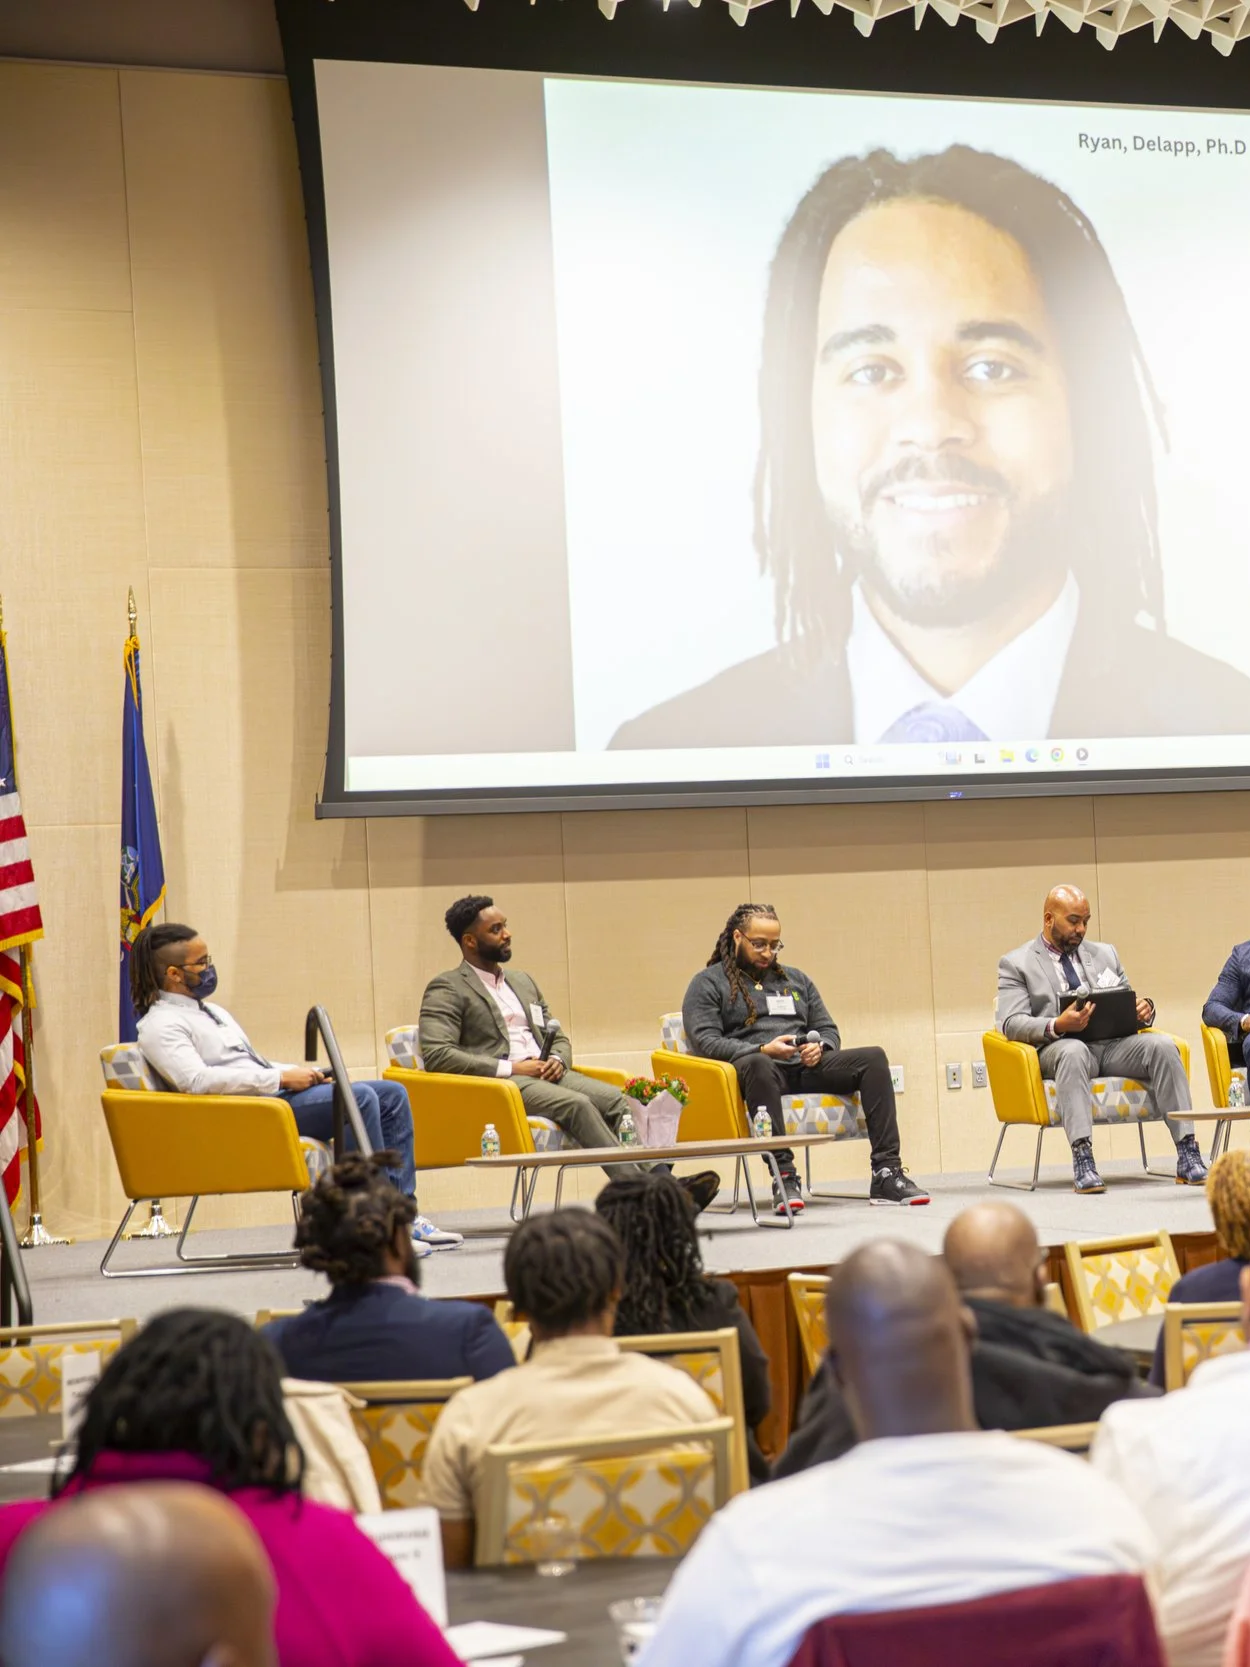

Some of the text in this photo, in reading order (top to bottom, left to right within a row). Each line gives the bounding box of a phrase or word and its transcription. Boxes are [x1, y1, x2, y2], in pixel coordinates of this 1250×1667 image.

[1078, 133, 1247, 157] Ryan, Delapp, Ph.D
